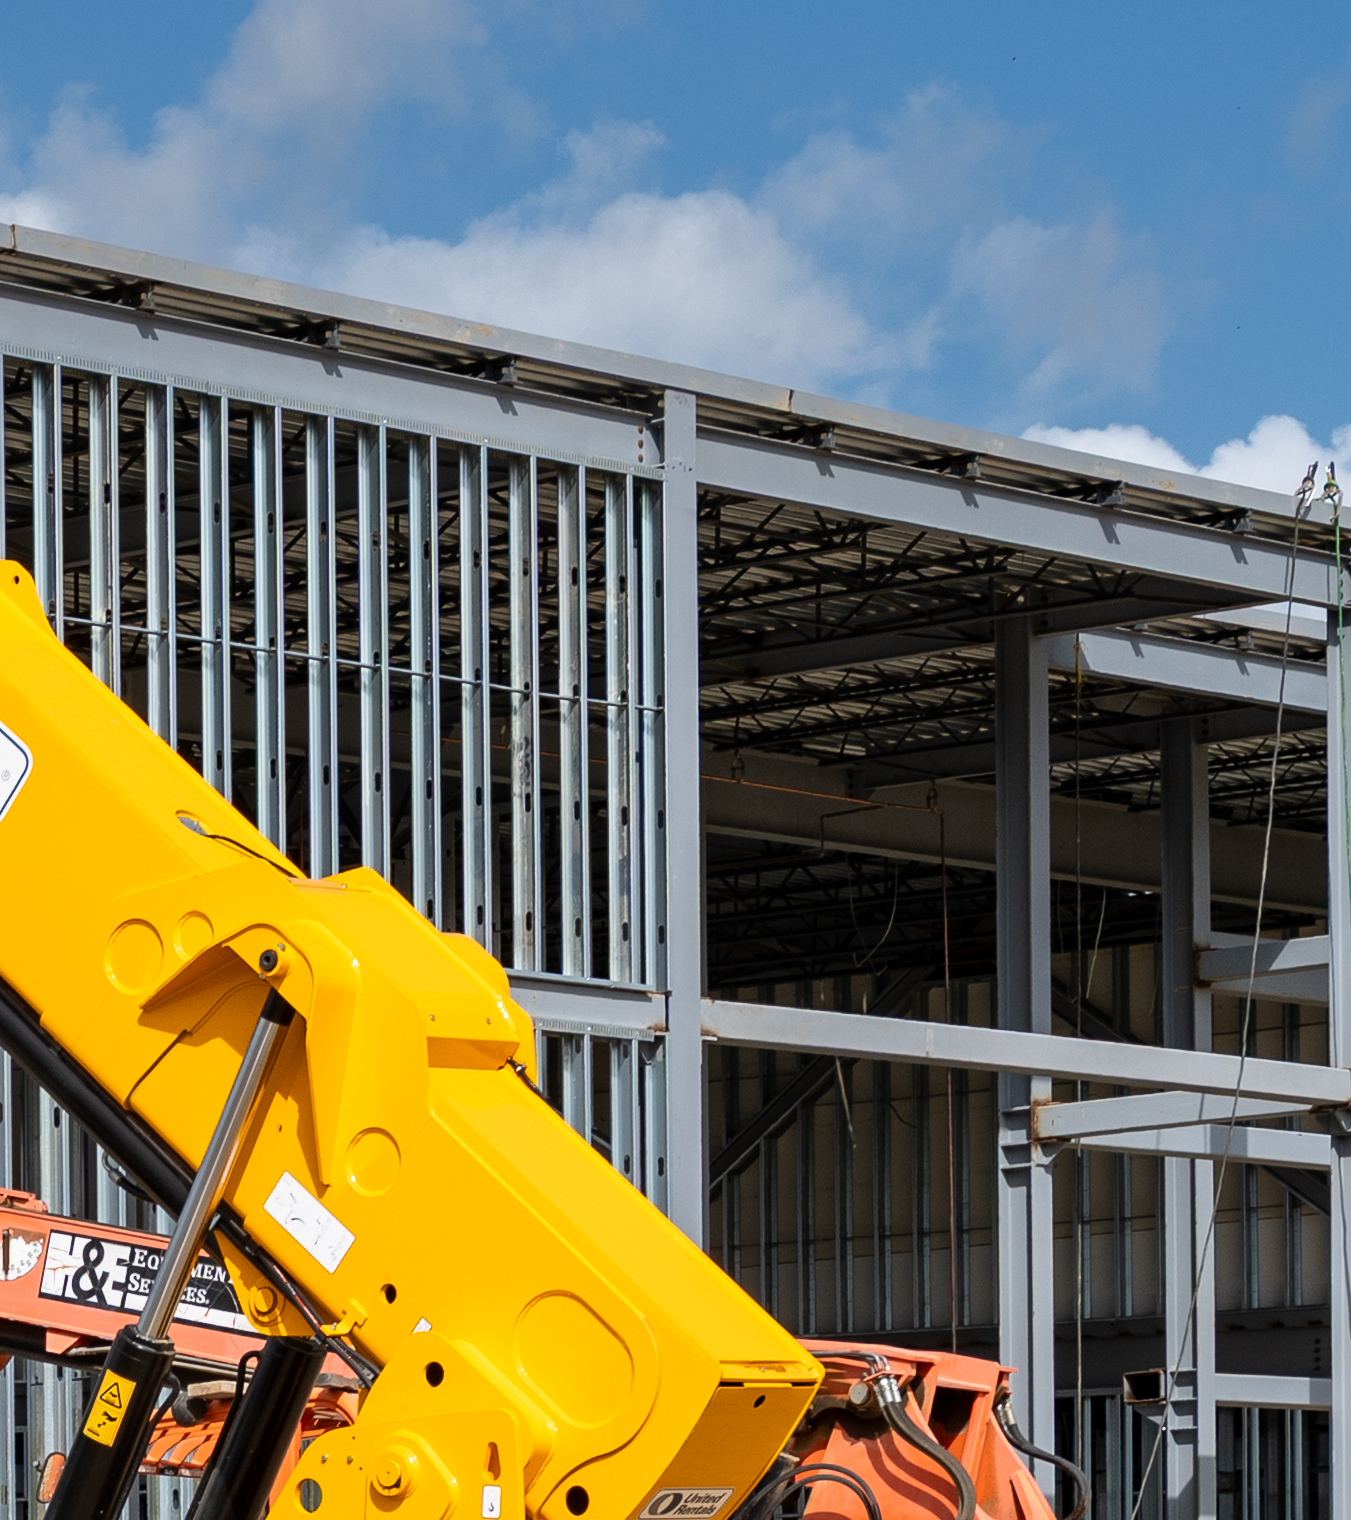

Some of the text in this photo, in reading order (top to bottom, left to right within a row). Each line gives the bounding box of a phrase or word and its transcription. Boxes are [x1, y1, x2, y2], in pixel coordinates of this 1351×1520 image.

[41, 1232, 131, 1308] H&E
[132, 1248, 234, 1283] EQMEN
[127, 1272, 210, 1305] SEES.
[674, 1504, 717, 1516] Rentals
[683, 1492, 724, 1505] United
